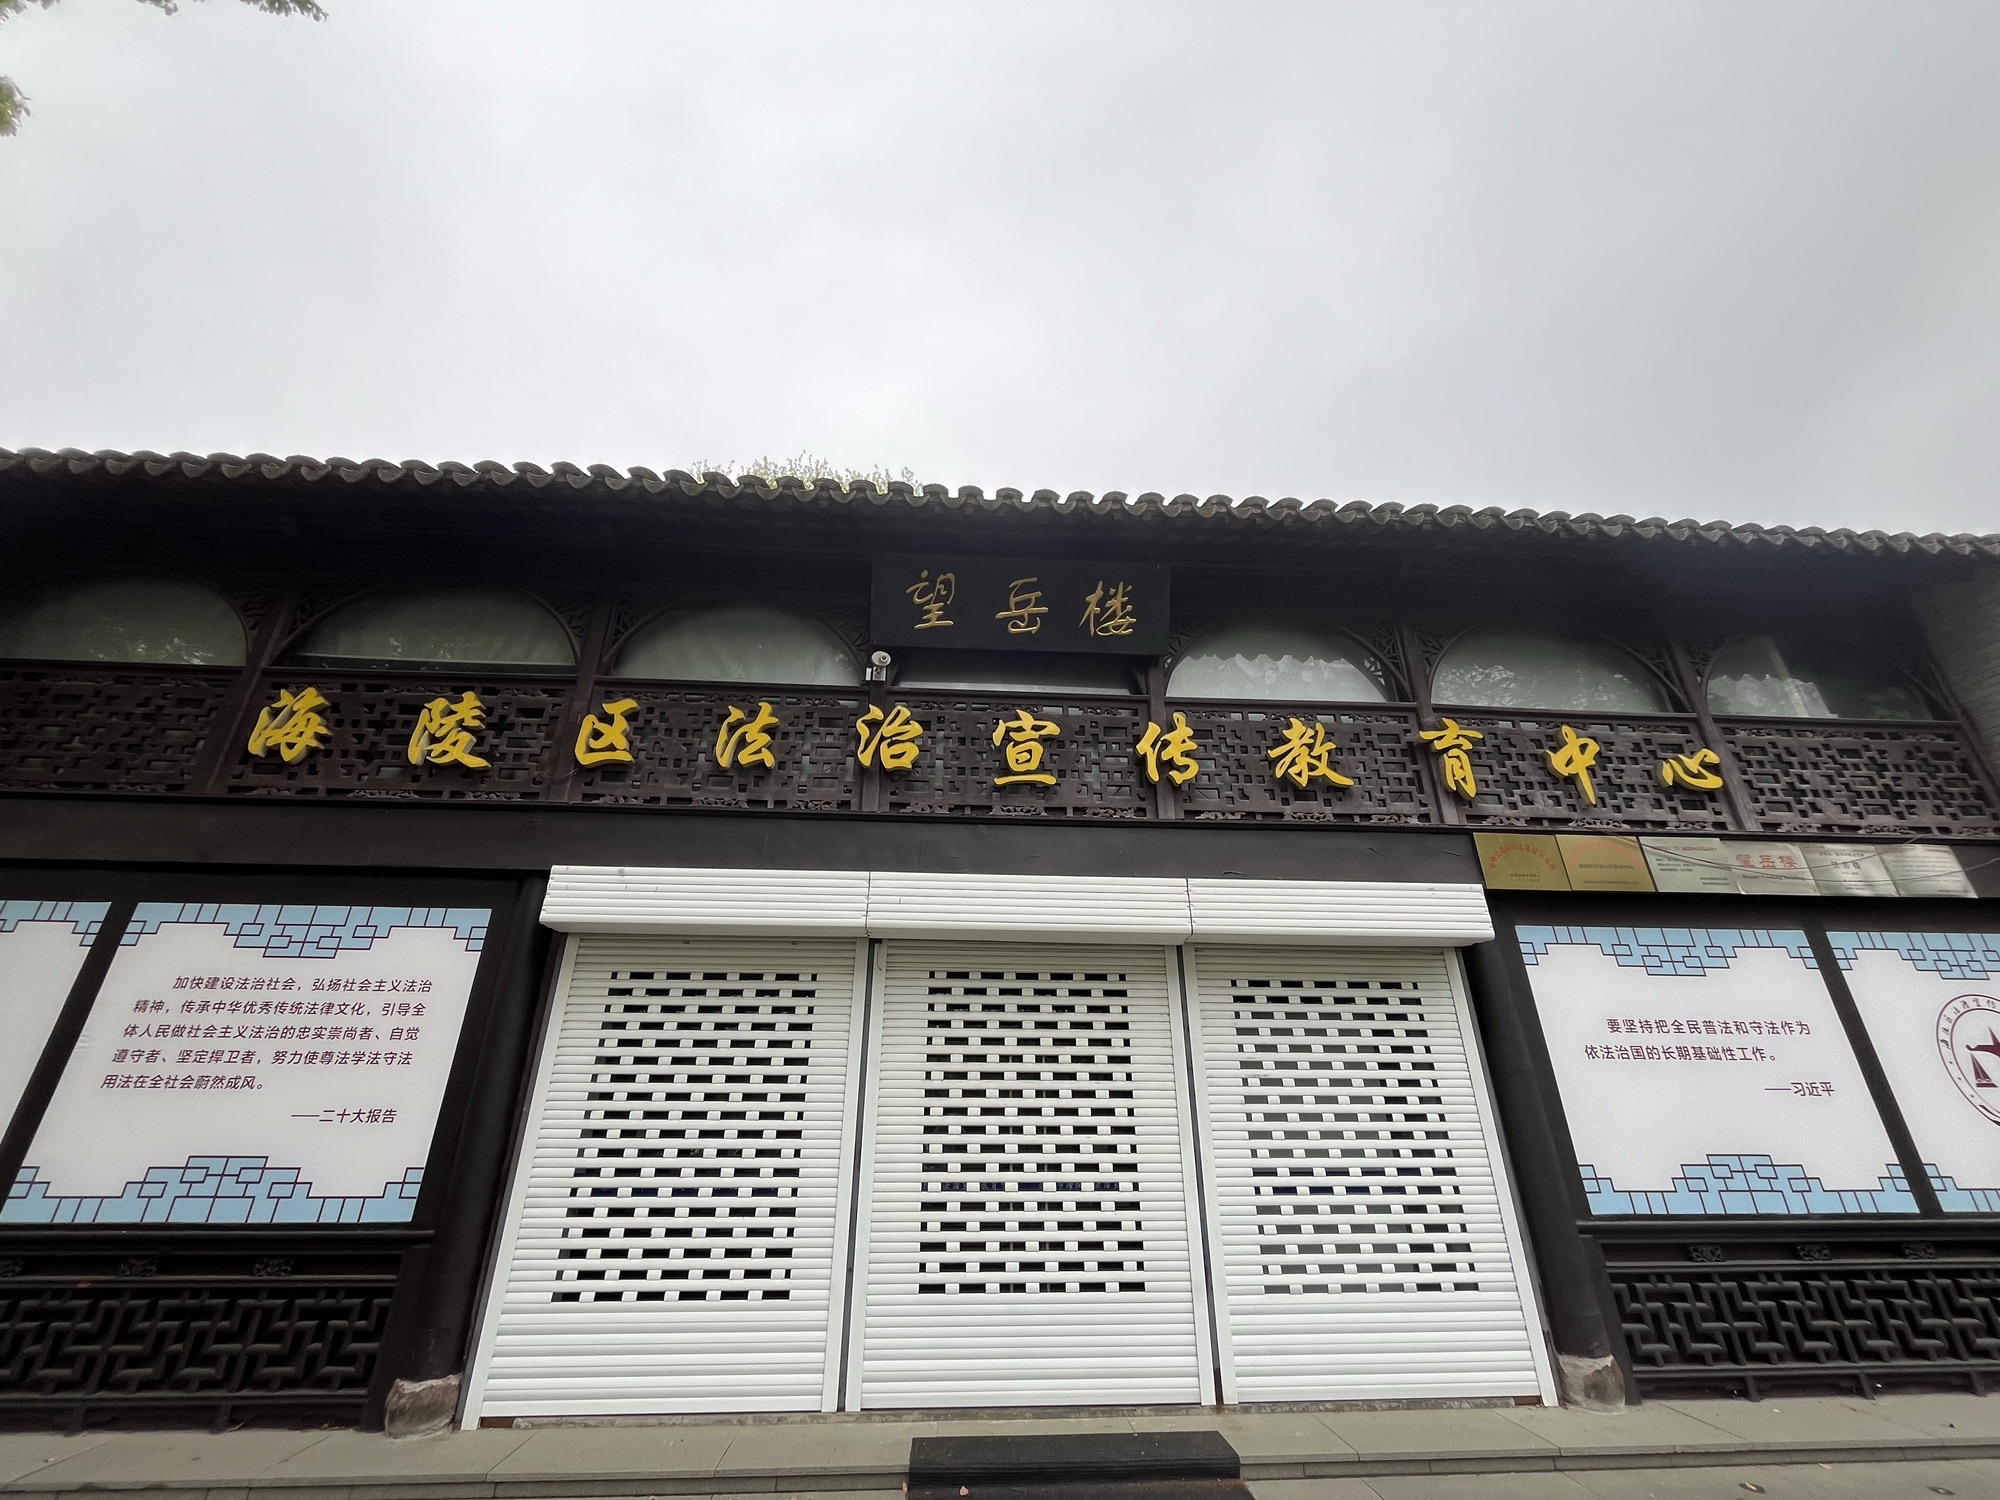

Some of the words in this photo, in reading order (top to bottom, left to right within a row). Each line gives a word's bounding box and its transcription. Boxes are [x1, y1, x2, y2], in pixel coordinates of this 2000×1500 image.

[905, 569, 1137, 637] 望岳楼
[247, 687, 1724, 806] 海陵区法治宣传教育中心
[172, 975, 433, 994] 加快建设法治社会，弘扬社会主义法治
[132, 998, 427, 1017] 精神，传承中华优秀传统法律文化，引导全
[122, 1023, 420, 1042] 体人民做社会主义法治的忠实崇尚者、自觉
[1605, 1018, 1812, 1037] 要坚持把全民普法和守法作为
[111, 1048, 414, 1067] 遵守者、坚定捍卫者，努力使尊法学法守法
[1584, 1044, 1777, 1063] 依法治国的长期基础性工作。
[99, 1073, 265, 1091] 用法在全社会蔚然成风。
